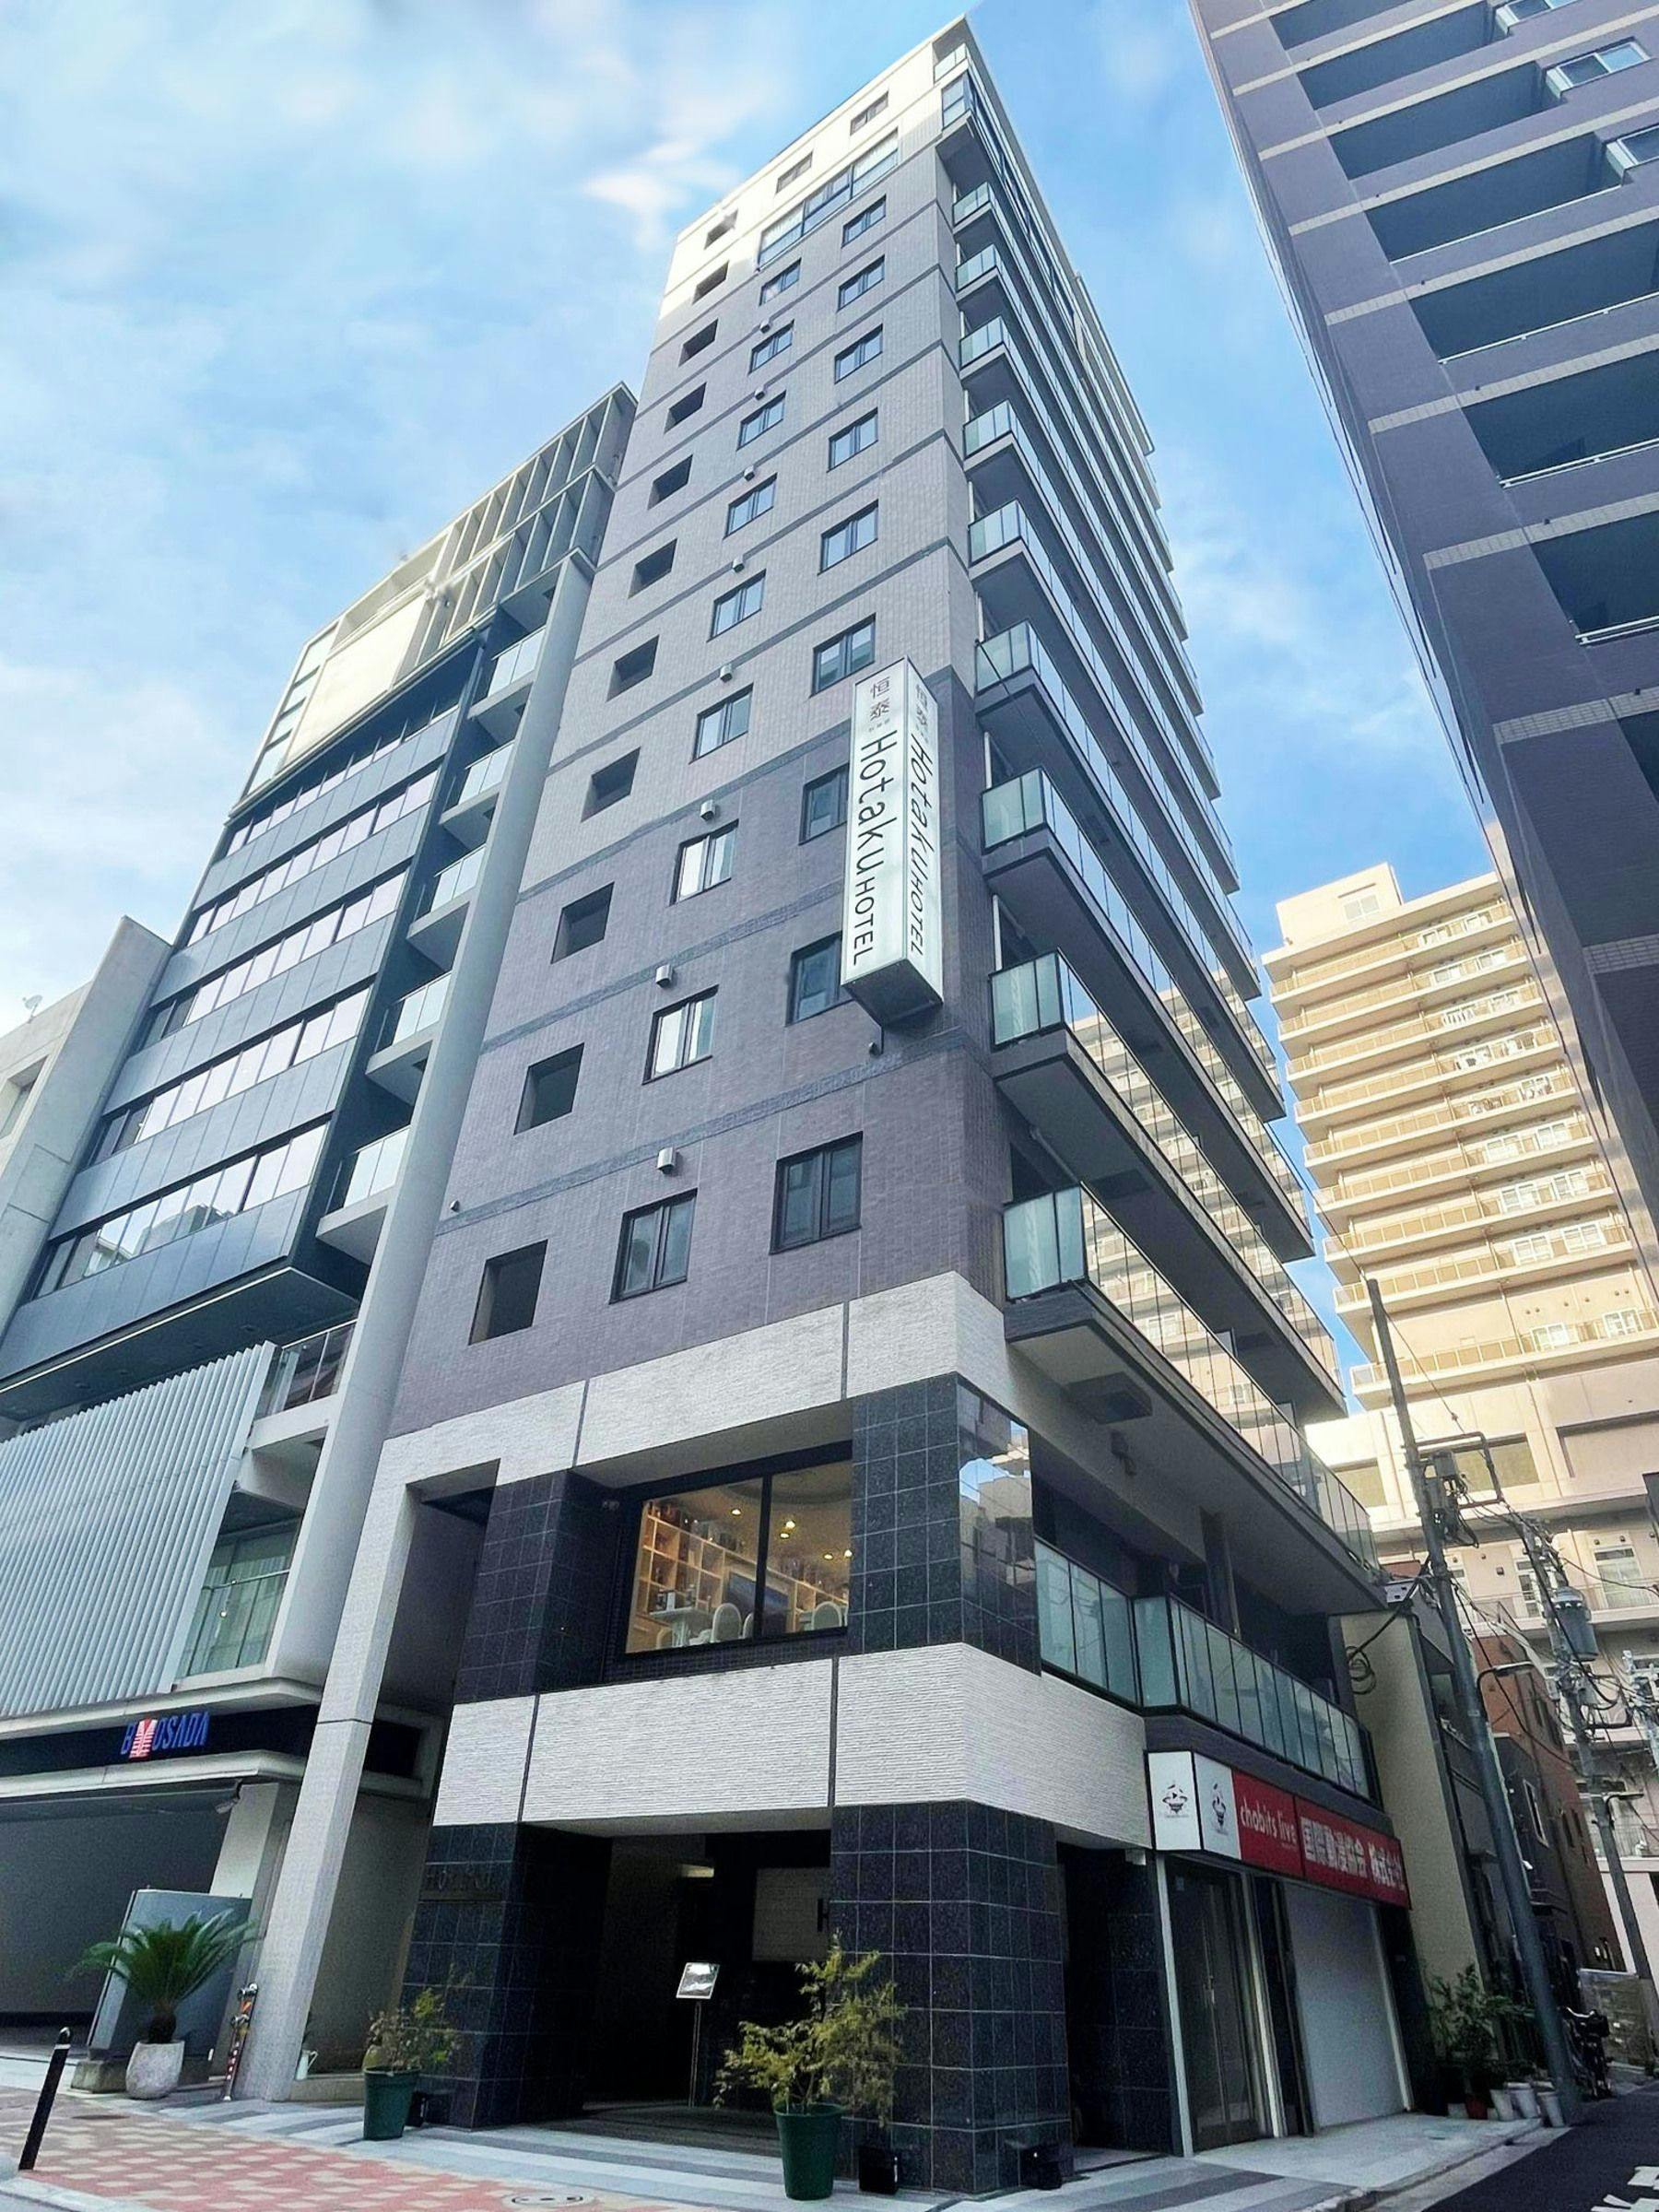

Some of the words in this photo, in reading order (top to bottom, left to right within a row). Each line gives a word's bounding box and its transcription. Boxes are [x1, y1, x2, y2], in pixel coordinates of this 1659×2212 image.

[856, 729, 898, 876] Hotaku
[911, 732, 935, 880] Hotaku
[853, 877, 876, 966] HOTEL
[911, 869, 924, 956] HOTEL
